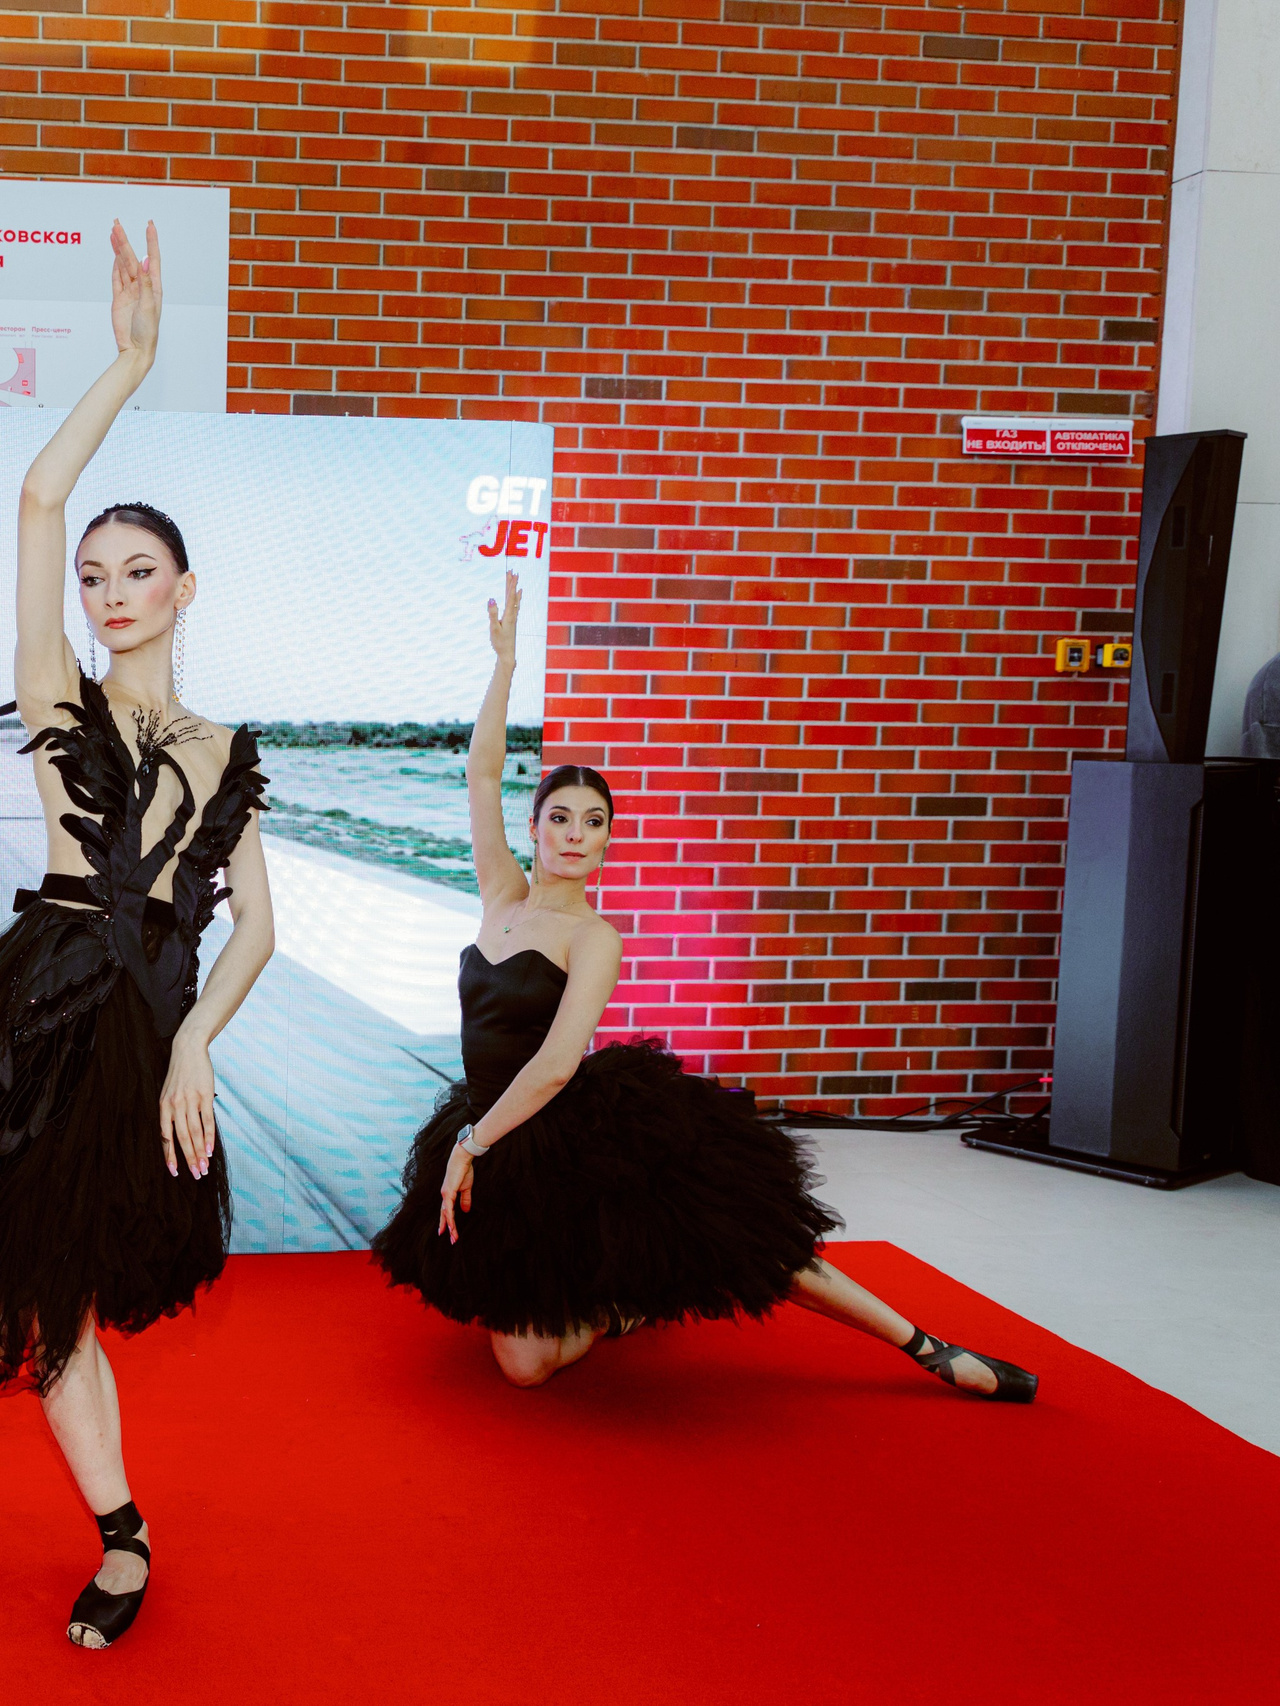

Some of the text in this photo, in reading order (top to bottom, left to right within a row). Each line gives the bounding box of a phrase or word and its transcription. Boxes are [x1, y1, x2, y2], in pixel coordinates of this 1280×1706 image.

[31, 326, 72, 334] Пресс-центр
[995, 429, 1018, 438] ГАЗ
[1054, 432, 1126, 441] АВТОМАТИКА
[967, 440, 1046, 451] НЕ ВХОДИТЬ!
[1056, 442, 1124, 451] ОТКЛЮЧЕНА
[466, 475, 548, 517] GET
[478, 520, 549, 559] JET
